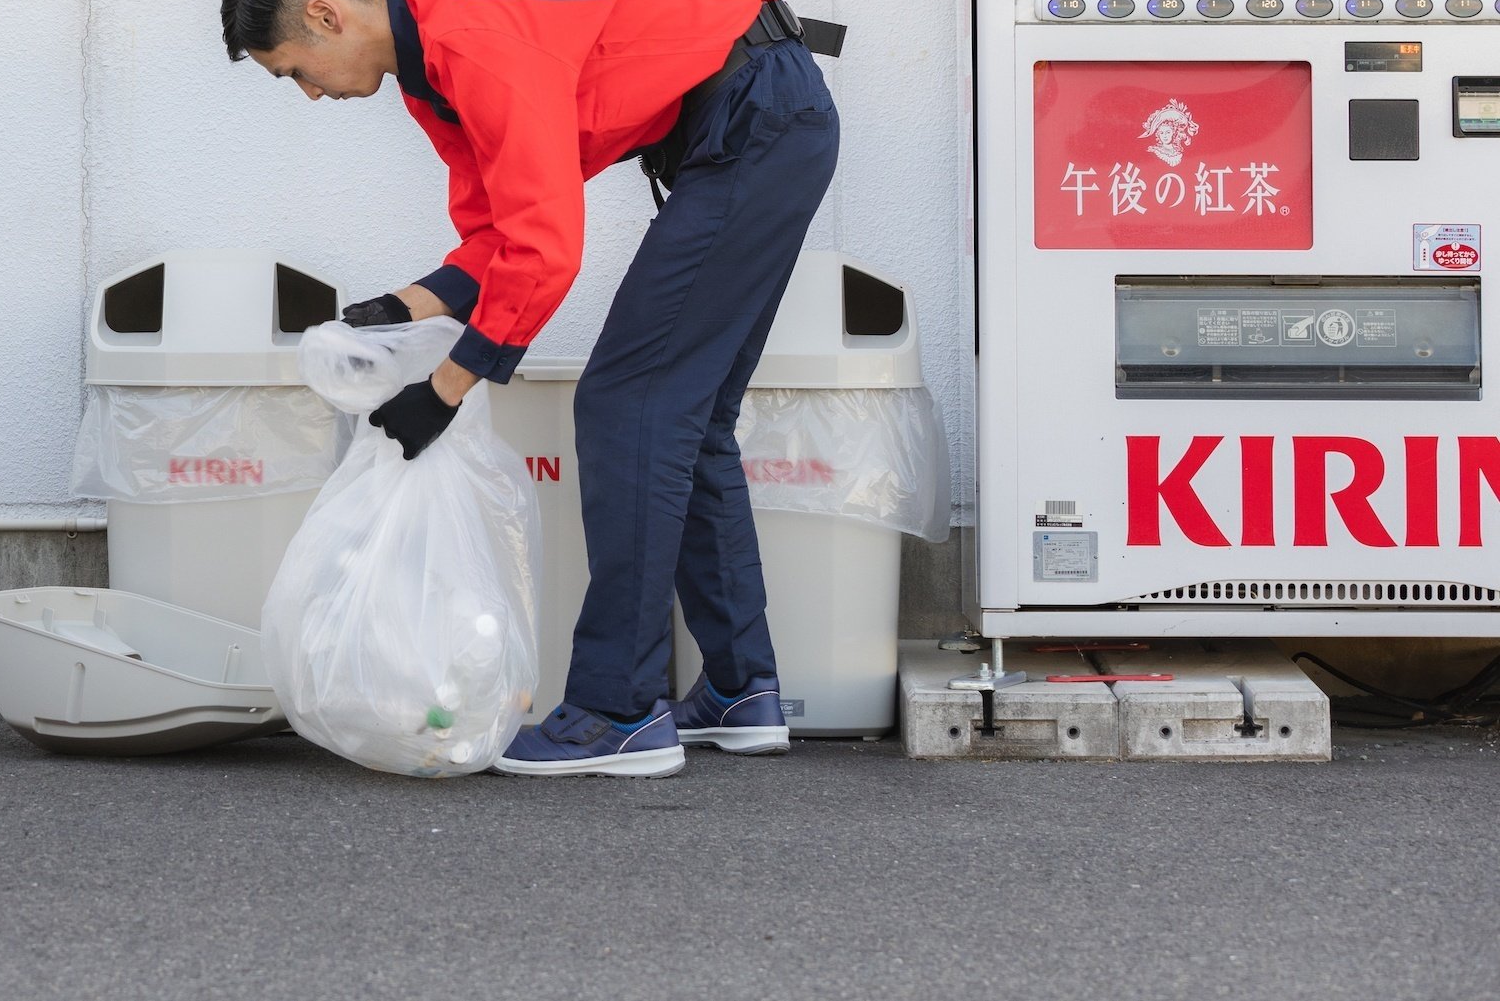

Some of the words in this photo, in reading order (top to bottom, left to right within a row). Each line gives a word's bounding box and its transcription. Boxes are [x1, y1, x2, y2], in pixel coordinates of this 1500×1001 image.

[1059, 161, 1281, 217] 午後の紅茶
[168, 458, 264, 484] KIRIN
